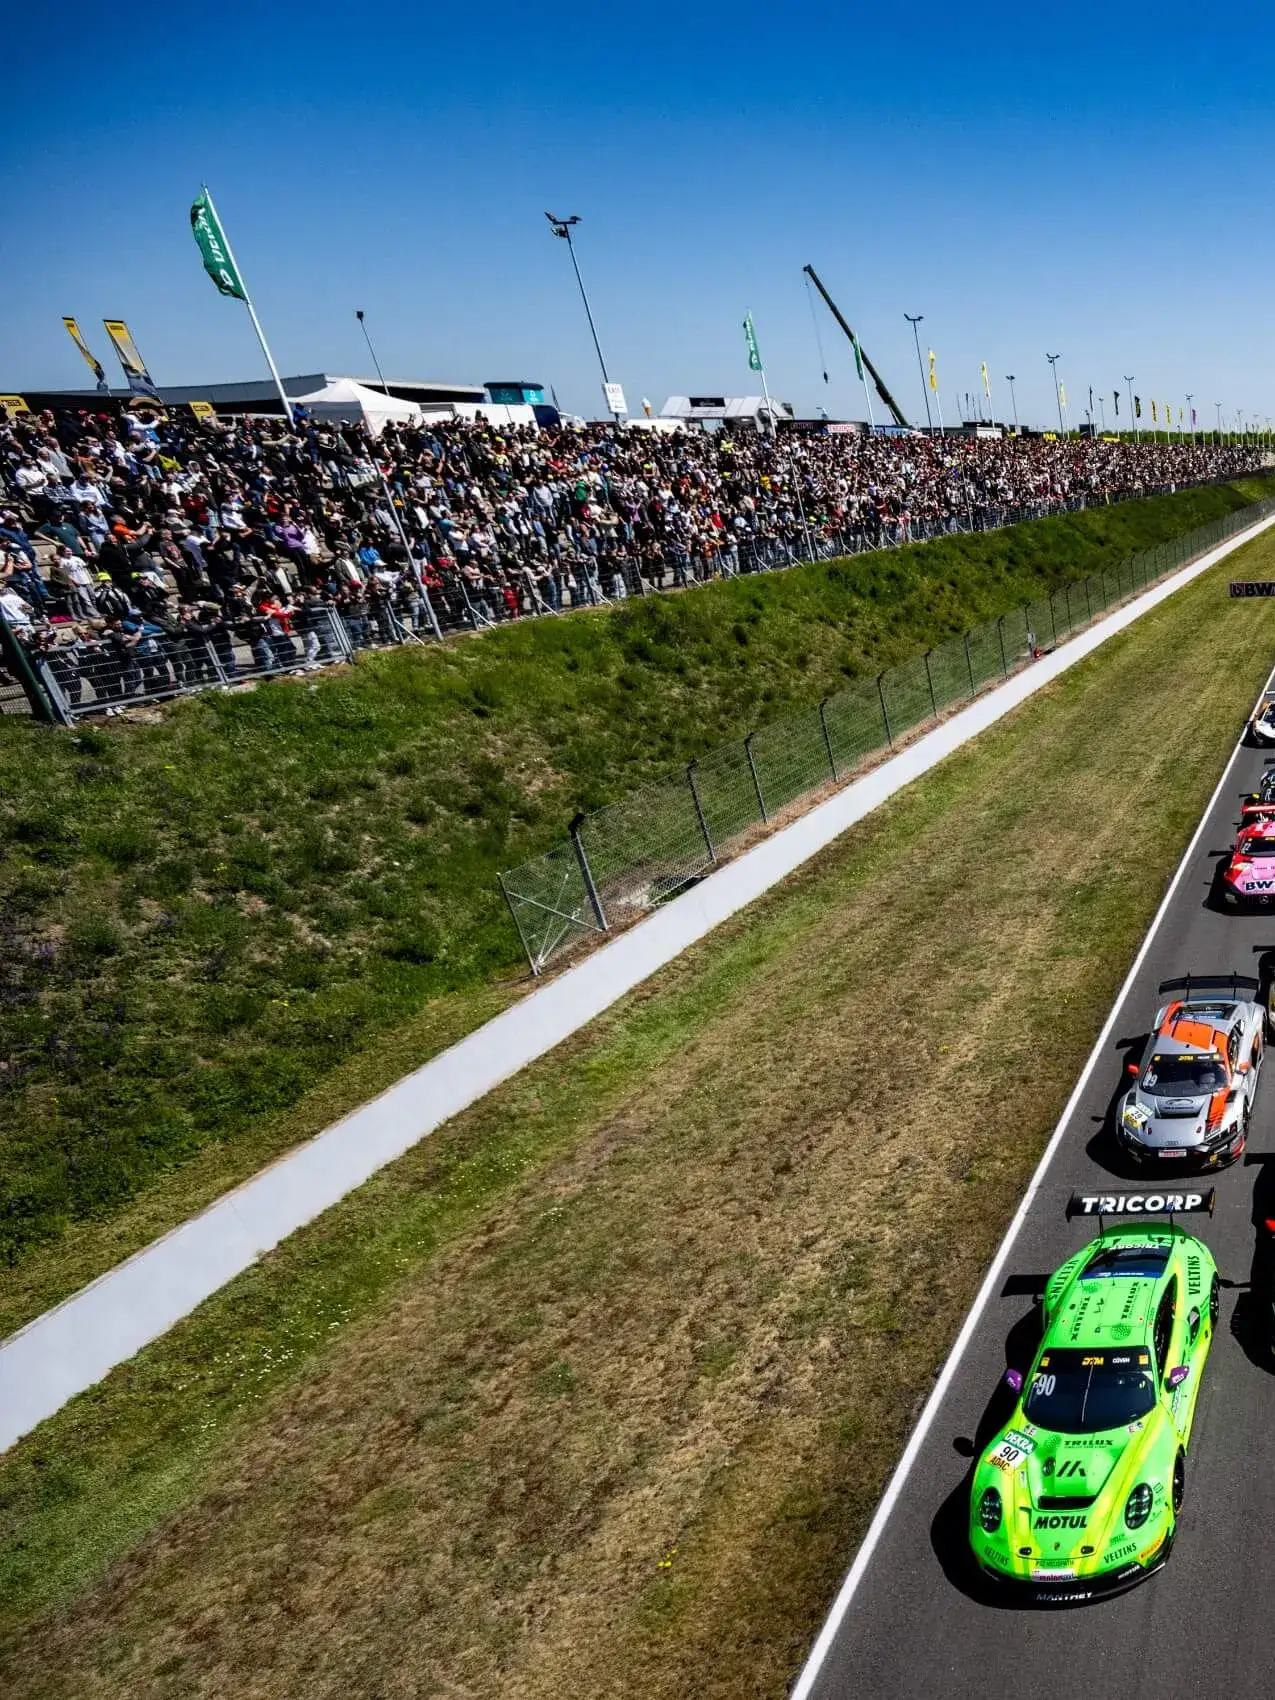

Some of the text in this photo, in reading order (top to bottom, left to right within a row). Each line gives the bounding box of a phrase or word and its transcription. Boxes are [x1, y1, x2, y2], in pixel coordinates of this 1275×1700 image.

[1081, 1194, 1202, 1213] TRICORP
[1050, 1259, 1079, 1302] VELTINS
[1187, 1255, 1201, 1297] VELTINS
[1082, 1357, 1104, 1366] DTM
[1036, 1375, 1056, 1396] 90
[1004, 1431, 1035, 1455] DEKRA
[990, 1456, 1011, 1472] ADAC
[1000, 1446, 1020, 1462] 90
[1033, 1516, 1087, 1529] MOTUL
[1103, 1542, 1137, 1565] VELTINS
